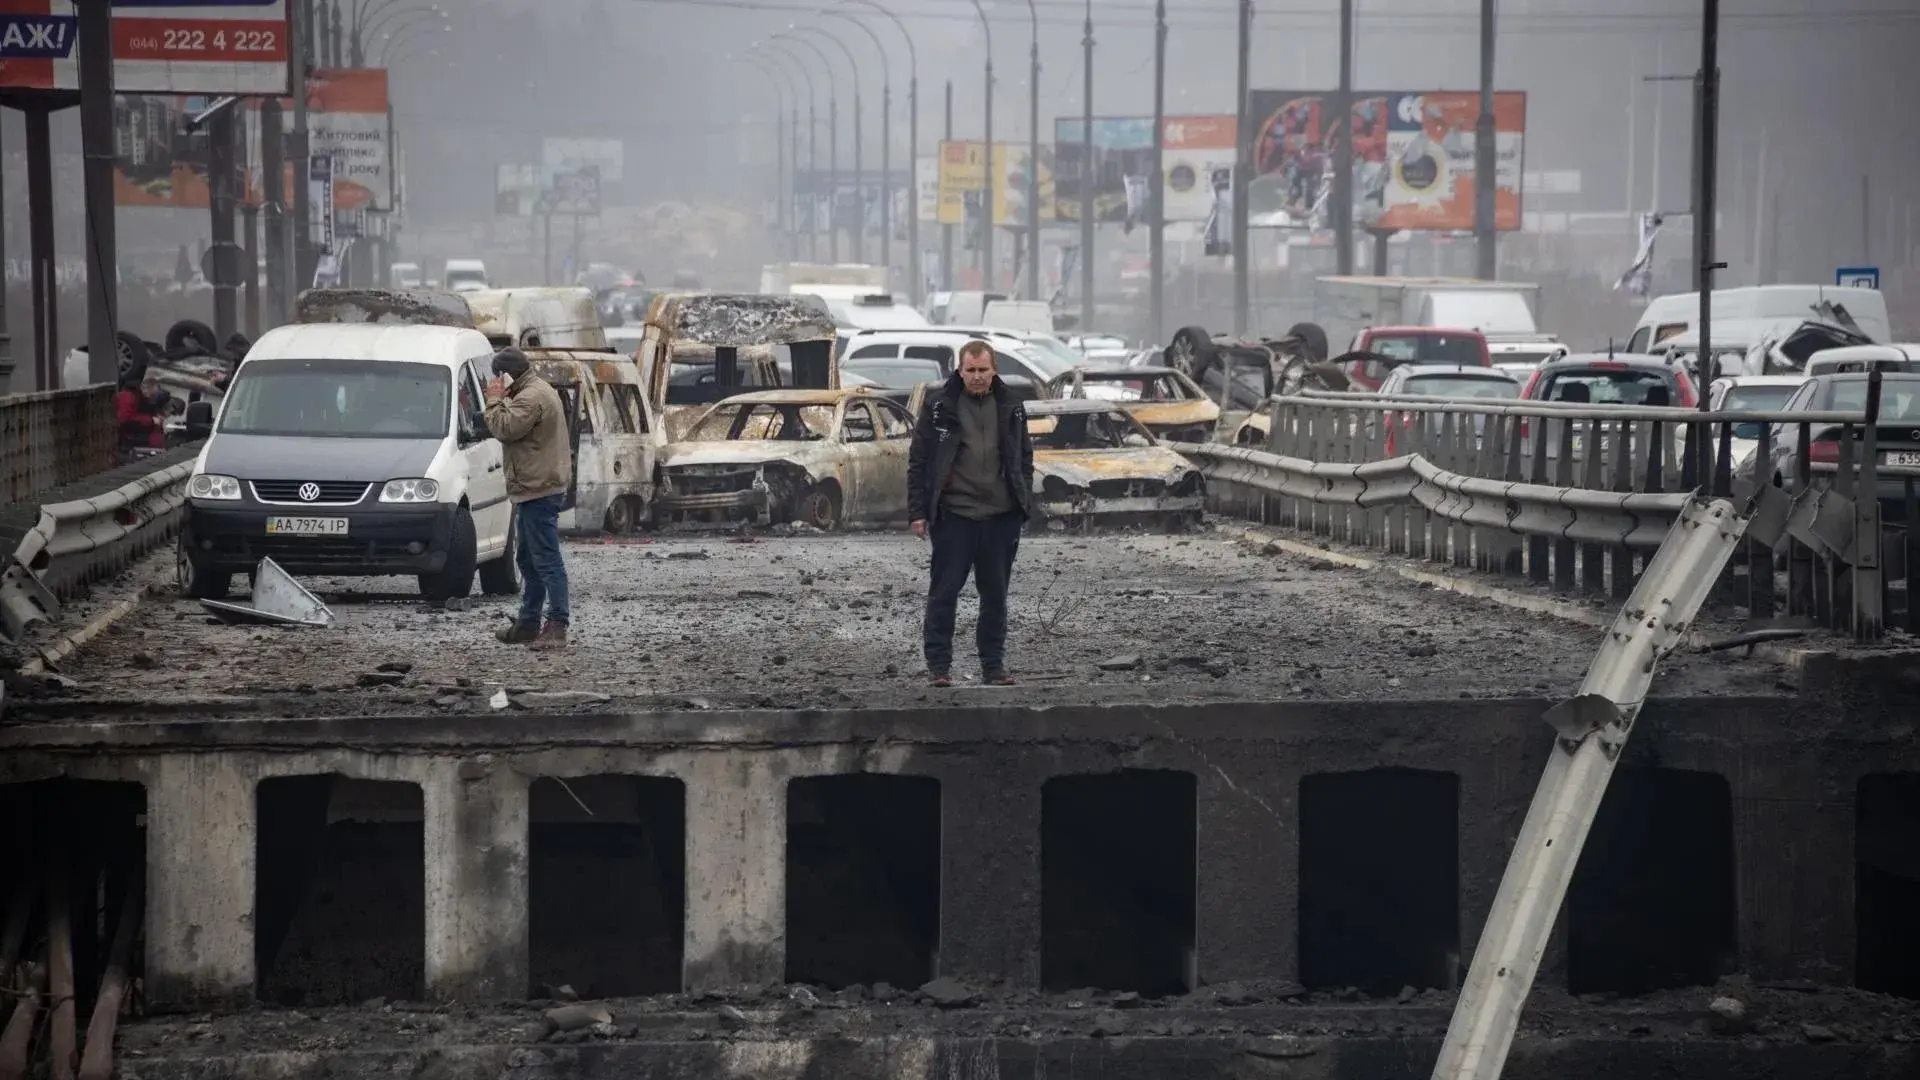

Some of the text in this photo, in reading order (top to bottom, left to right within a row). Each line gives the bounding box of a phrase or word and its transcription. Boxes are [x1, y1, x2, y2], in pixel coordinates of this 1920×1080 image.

[0, 22, 66, 49] АЖ!
[163, 29, 205, 49] 222
[213, 30, 227, 50] 4
[234, 31, 275, 51] 222
[275, 519, 293, 531] AA
[296, 519, 325, 532] 7974
